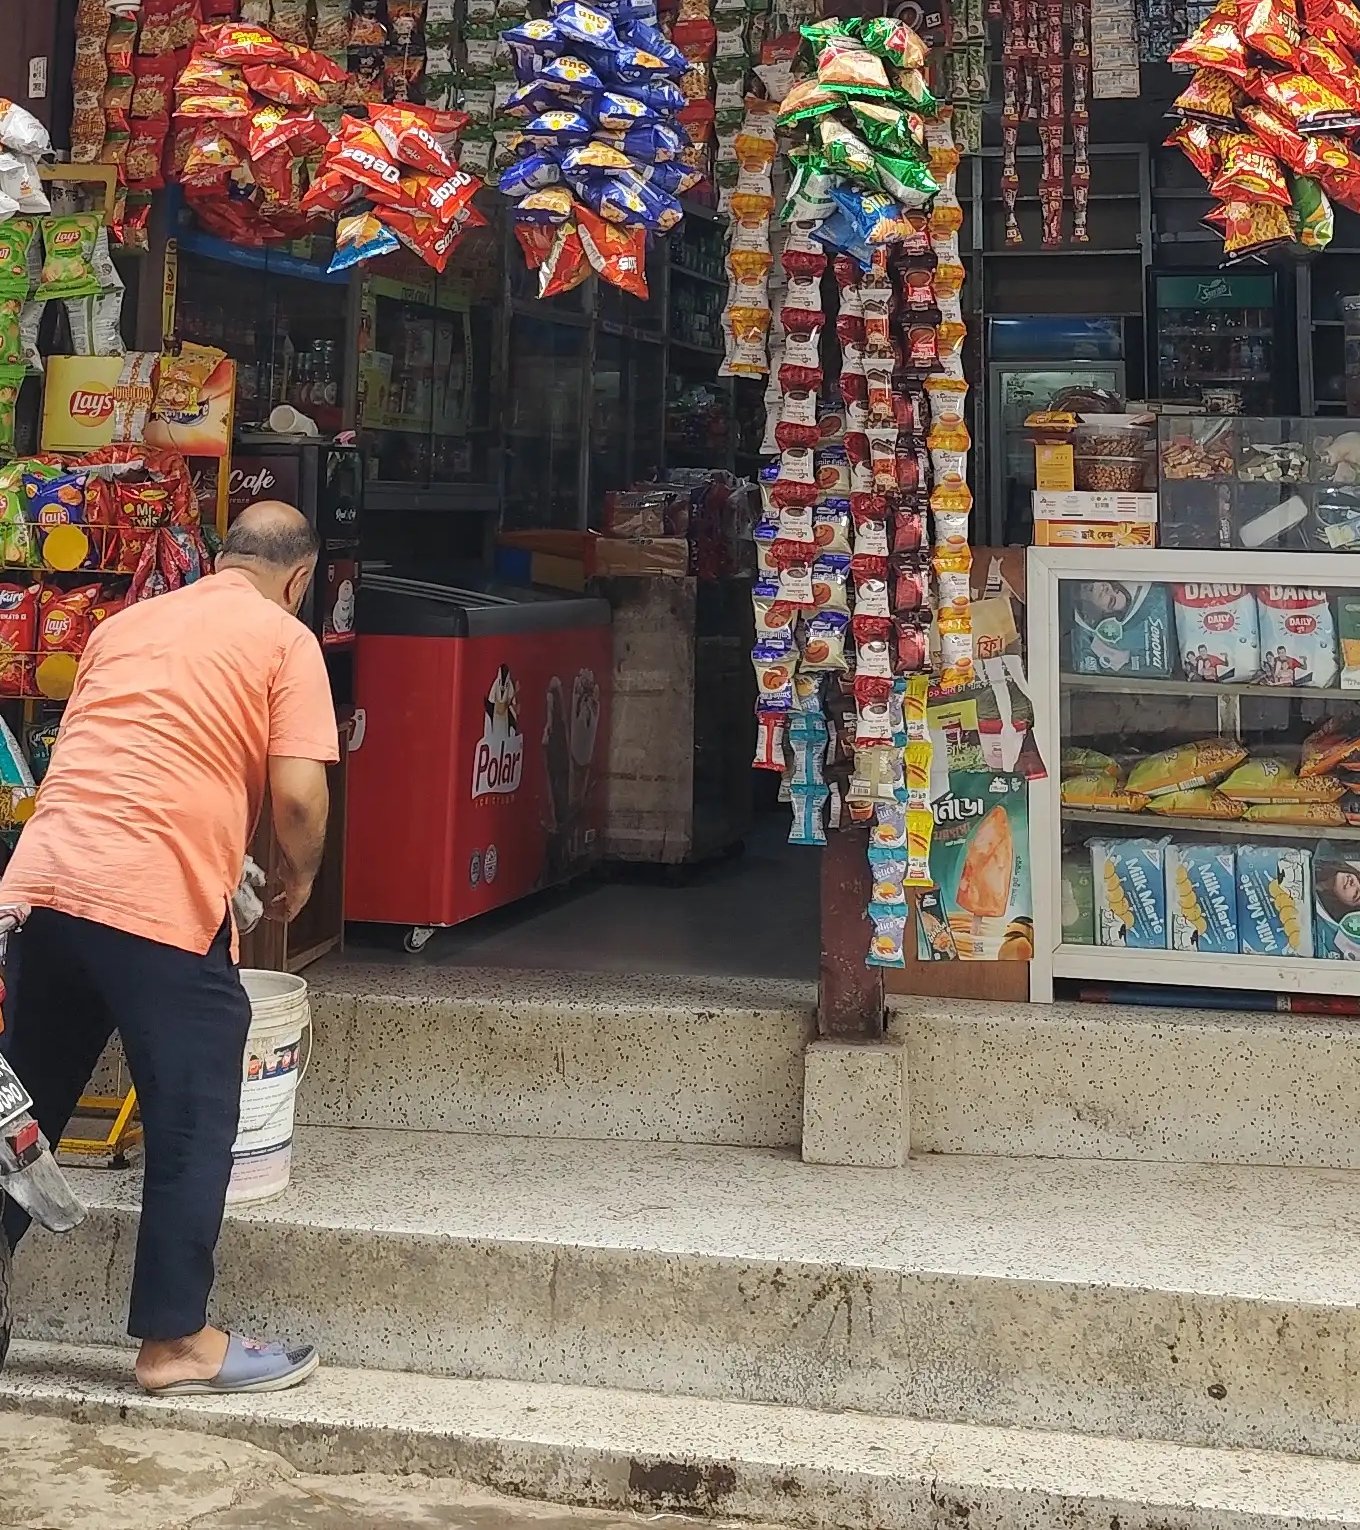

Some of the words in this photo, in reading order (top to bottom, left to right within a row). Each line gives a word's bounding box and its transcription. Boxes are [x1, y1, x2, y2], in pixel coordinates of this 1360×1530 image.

[229, 467, 276, 496] Café
[1206, 613, 1232, 625] DAILY
[1288, 615, 1314, 627] DAILY
[476, 740, 521, 793] Polar
[933, 796, 985, 824] র্নেডো
[1124, 857, 1149, 891] Milk
[1138, 890, 1165, 936] Marie
[1197, 862, 1222, 897] Milk
[1211, 895, 1237, 942] Marie
[1240, 873, 1265, 920] Marie
[1255, 918, 1279, 954] Milk
